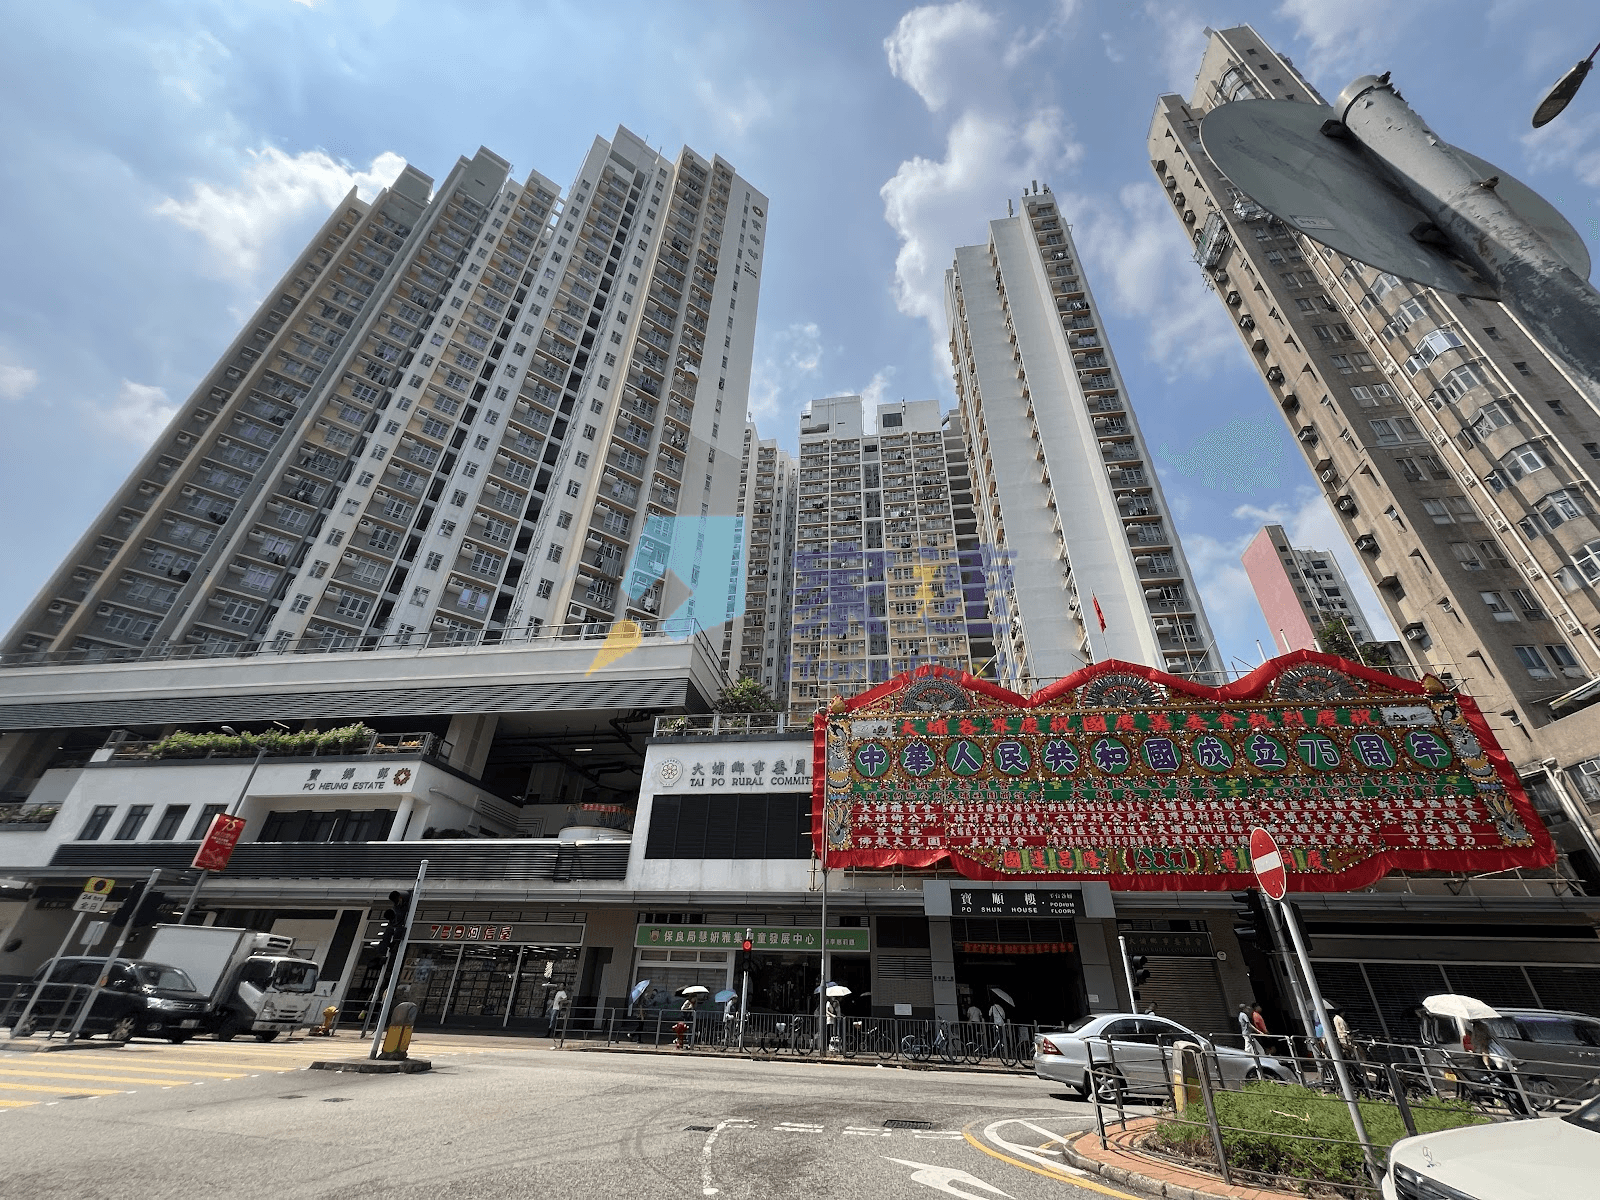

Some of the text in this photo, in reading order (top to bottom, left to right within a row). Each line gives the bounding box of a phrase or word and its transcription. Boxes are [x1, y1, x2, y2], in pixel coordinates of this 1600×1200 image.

[858, 732, 1449, 777] 中華人民共和國成立75周年
[308, 767, 391, 782] 寶鄉邨
[691, 758, 806, 777] 大埔鄉事委員
[302, 780, 386, 792] PO HEUNG ESTATE
[690, 778, 705, 787] TAI
[711, 777, 726, 787] PO
[731, 776, 764, 787] RURAL
[1220, 849, 1328, 870] 普同慶
[82, 893, 92, 901] 24
[959, 892, 1037, 906] 寶順樓
[961, 906, 1038, 914] PO SHUN HOUSE
[430, 924, 514, 941] 759阿信屋
